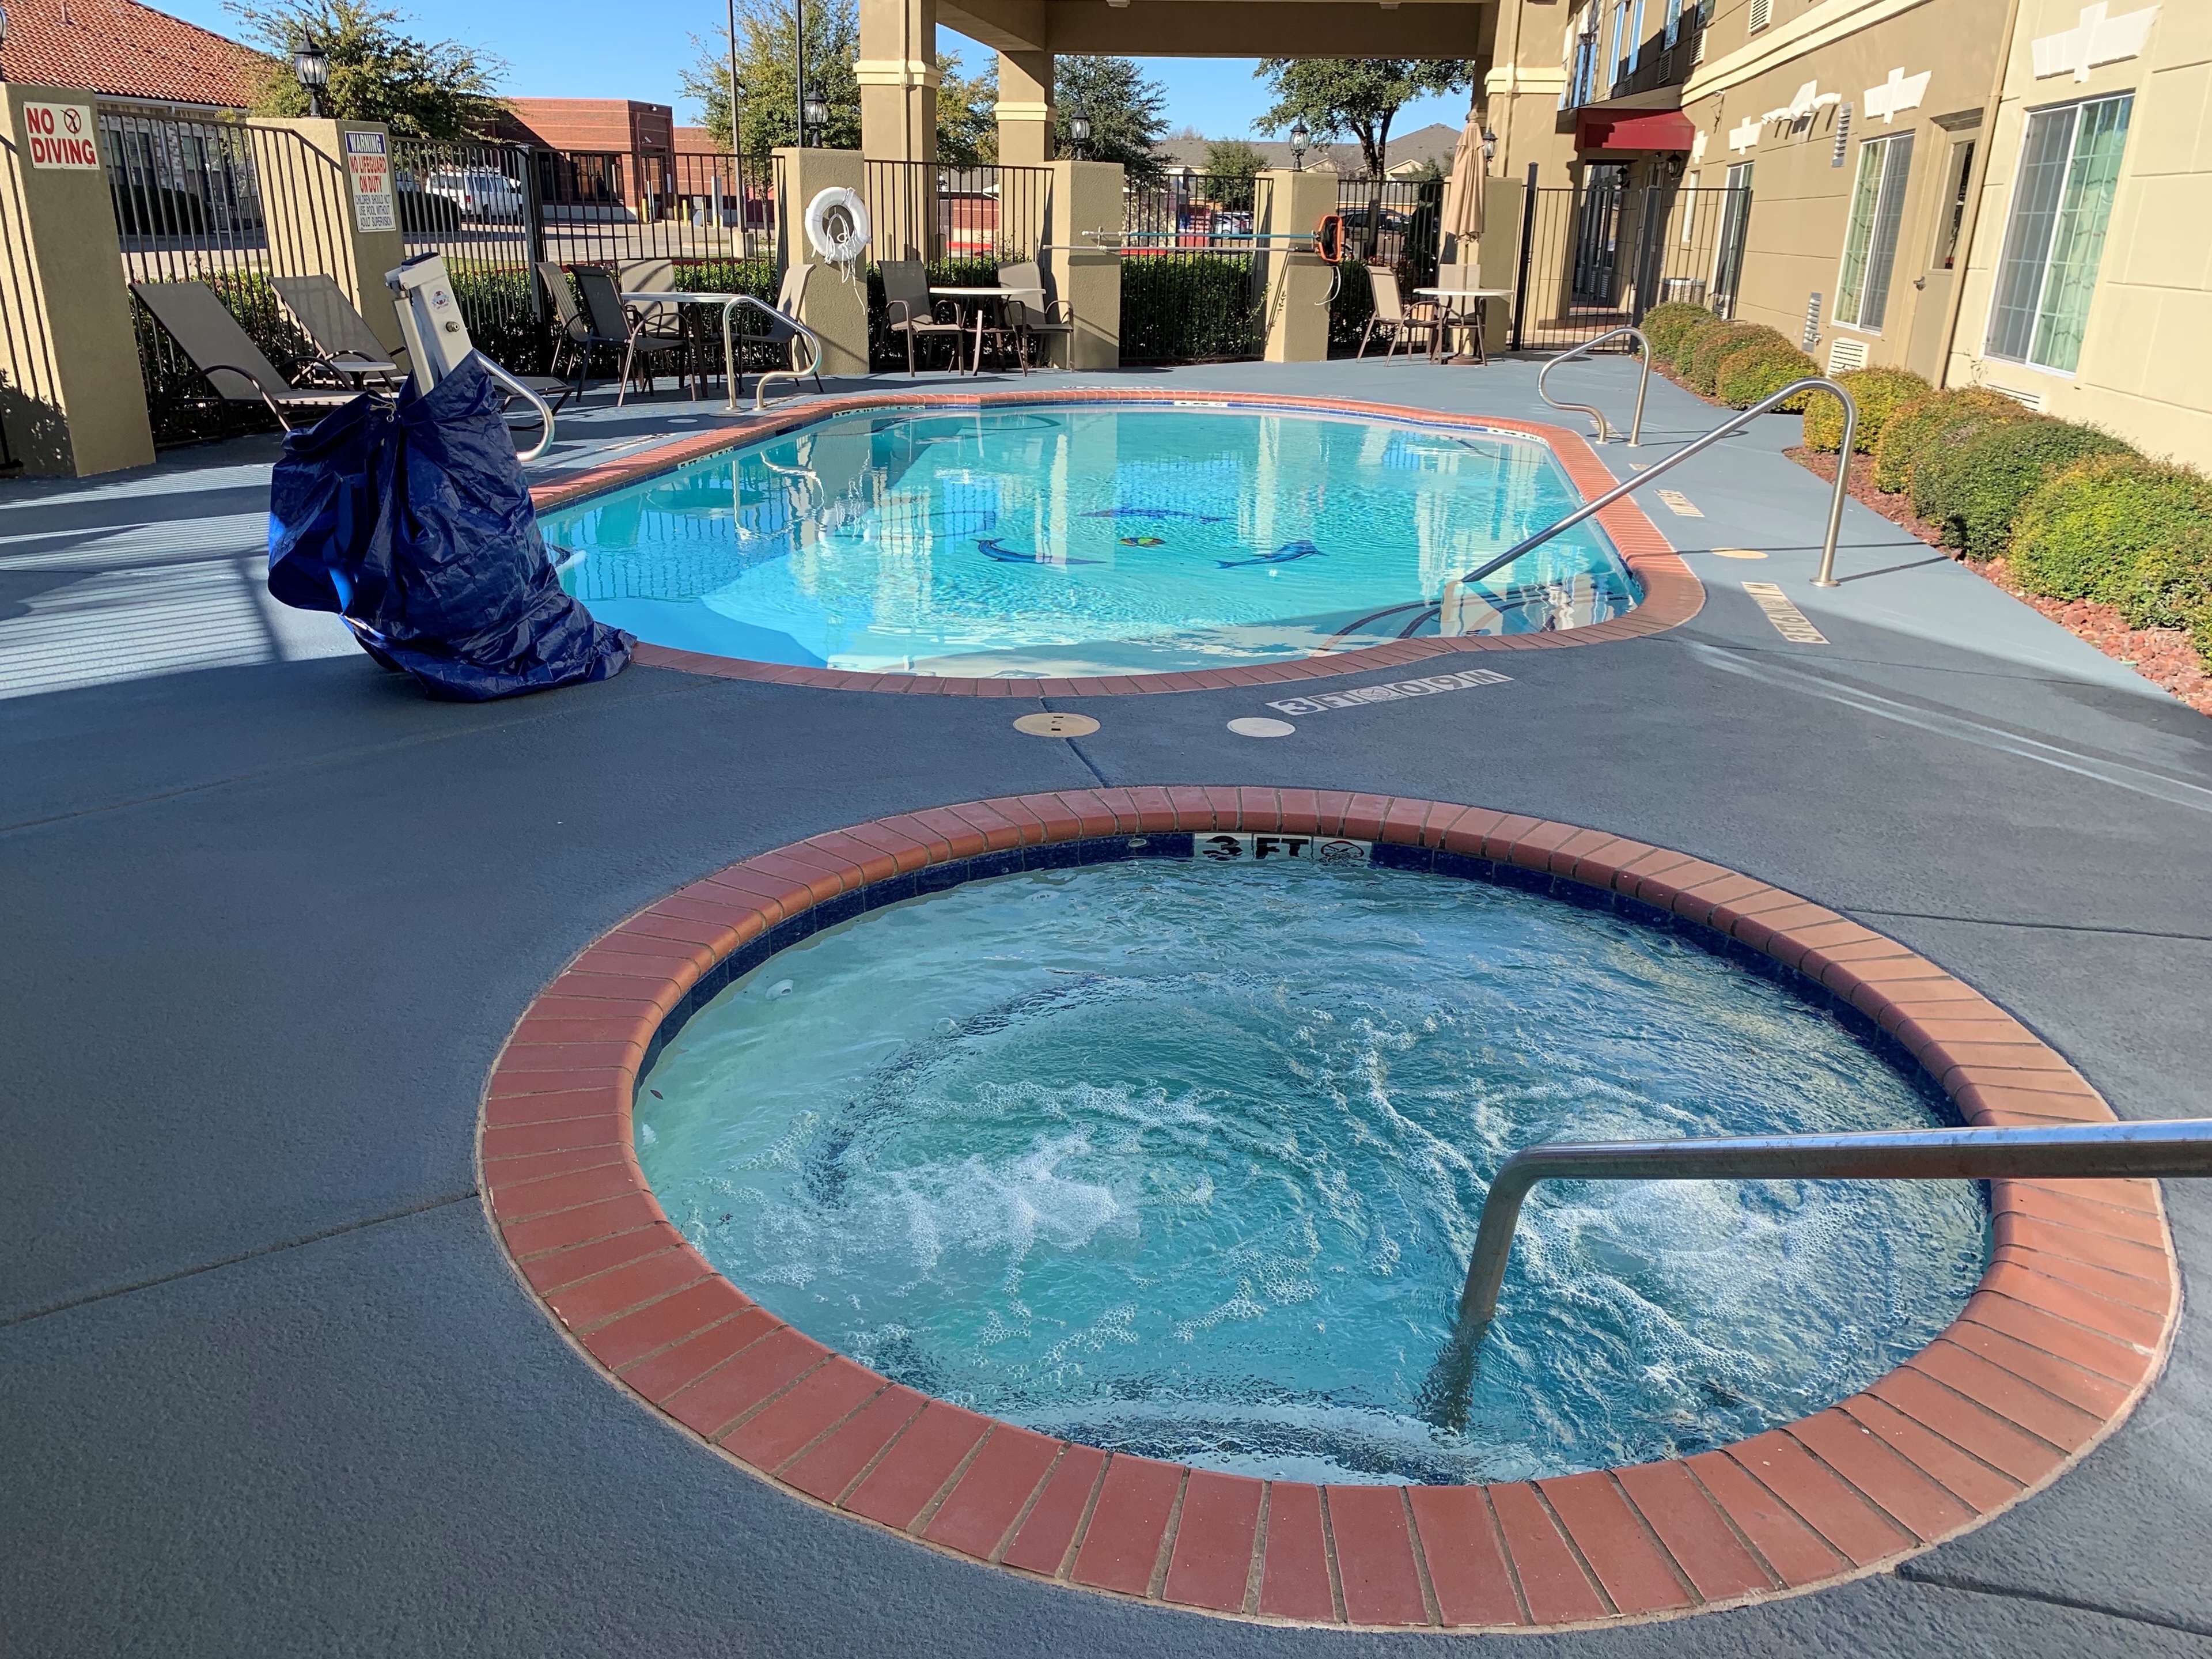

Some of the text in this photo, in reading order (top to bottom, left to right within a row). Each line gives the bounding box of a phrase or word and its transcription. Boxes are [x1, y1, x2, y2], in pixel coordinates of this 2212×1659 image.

[26, 108, 54, 134] NO
[31, 137, 96, 164] DIVING
[349, 134, 382, 153] WARNING
[350, 156, 386, 173] NO LIFEGUARD
[359, 175, 382, 193] ON DUTY
[367, 205, 376, 215] POOL
[1278, 700, 1319, 713] 3
[1202, 835, 1309, 861] 3 FT
